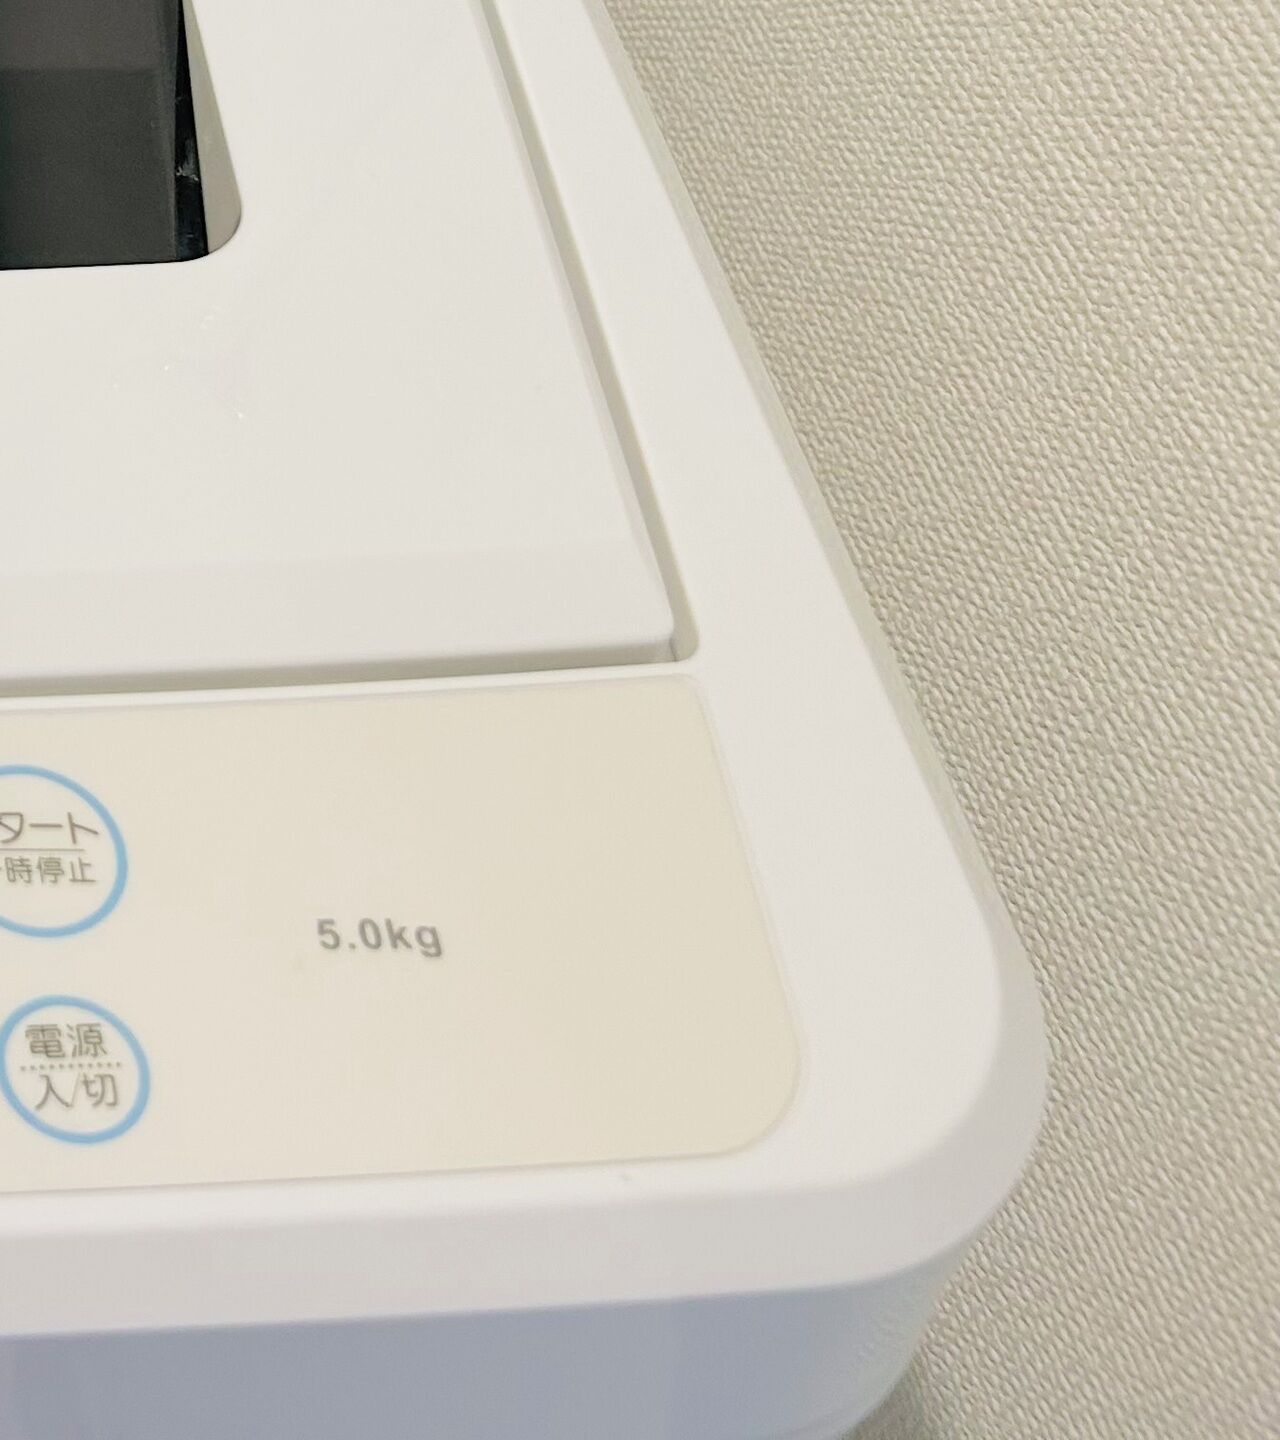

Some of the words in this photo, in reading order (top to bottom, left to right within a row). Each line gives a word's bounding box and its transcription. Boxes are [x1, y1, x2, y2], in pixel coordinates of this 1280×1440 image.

[317, 917, 444, 959] 5.0kg
[24, 1022, 108, 1060] 電源
[35, 1071, 119, 1110] 入/切
